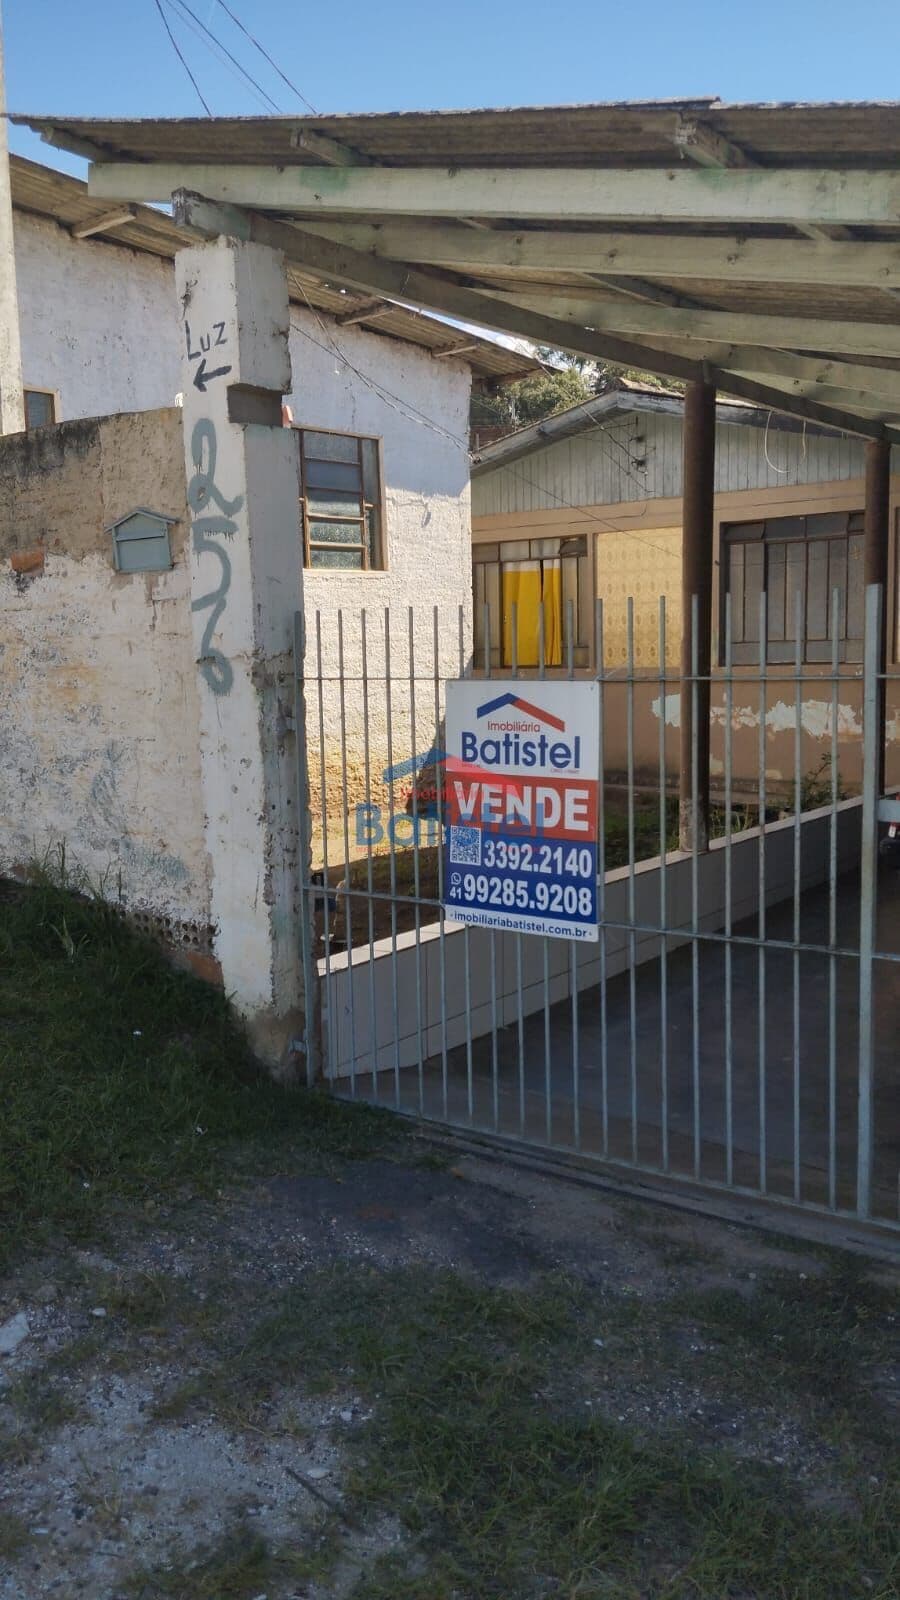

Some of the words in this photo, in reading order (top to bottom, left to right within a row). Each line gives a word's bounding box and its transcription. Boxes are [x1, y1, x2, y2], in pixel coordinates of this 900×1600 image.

[487, 720, 541, 732] Imobiliária
[461, 731, 581, 769] Batistel
[454, 781, 589, 832] VENDE
[484, 840, 593, 878] 3392.2140
[449, 886, 462, 899] 41
[463, 874, 593, 916] 99285.9208
[453, 911, 588, 938] imobiliariabatistel.com.br
